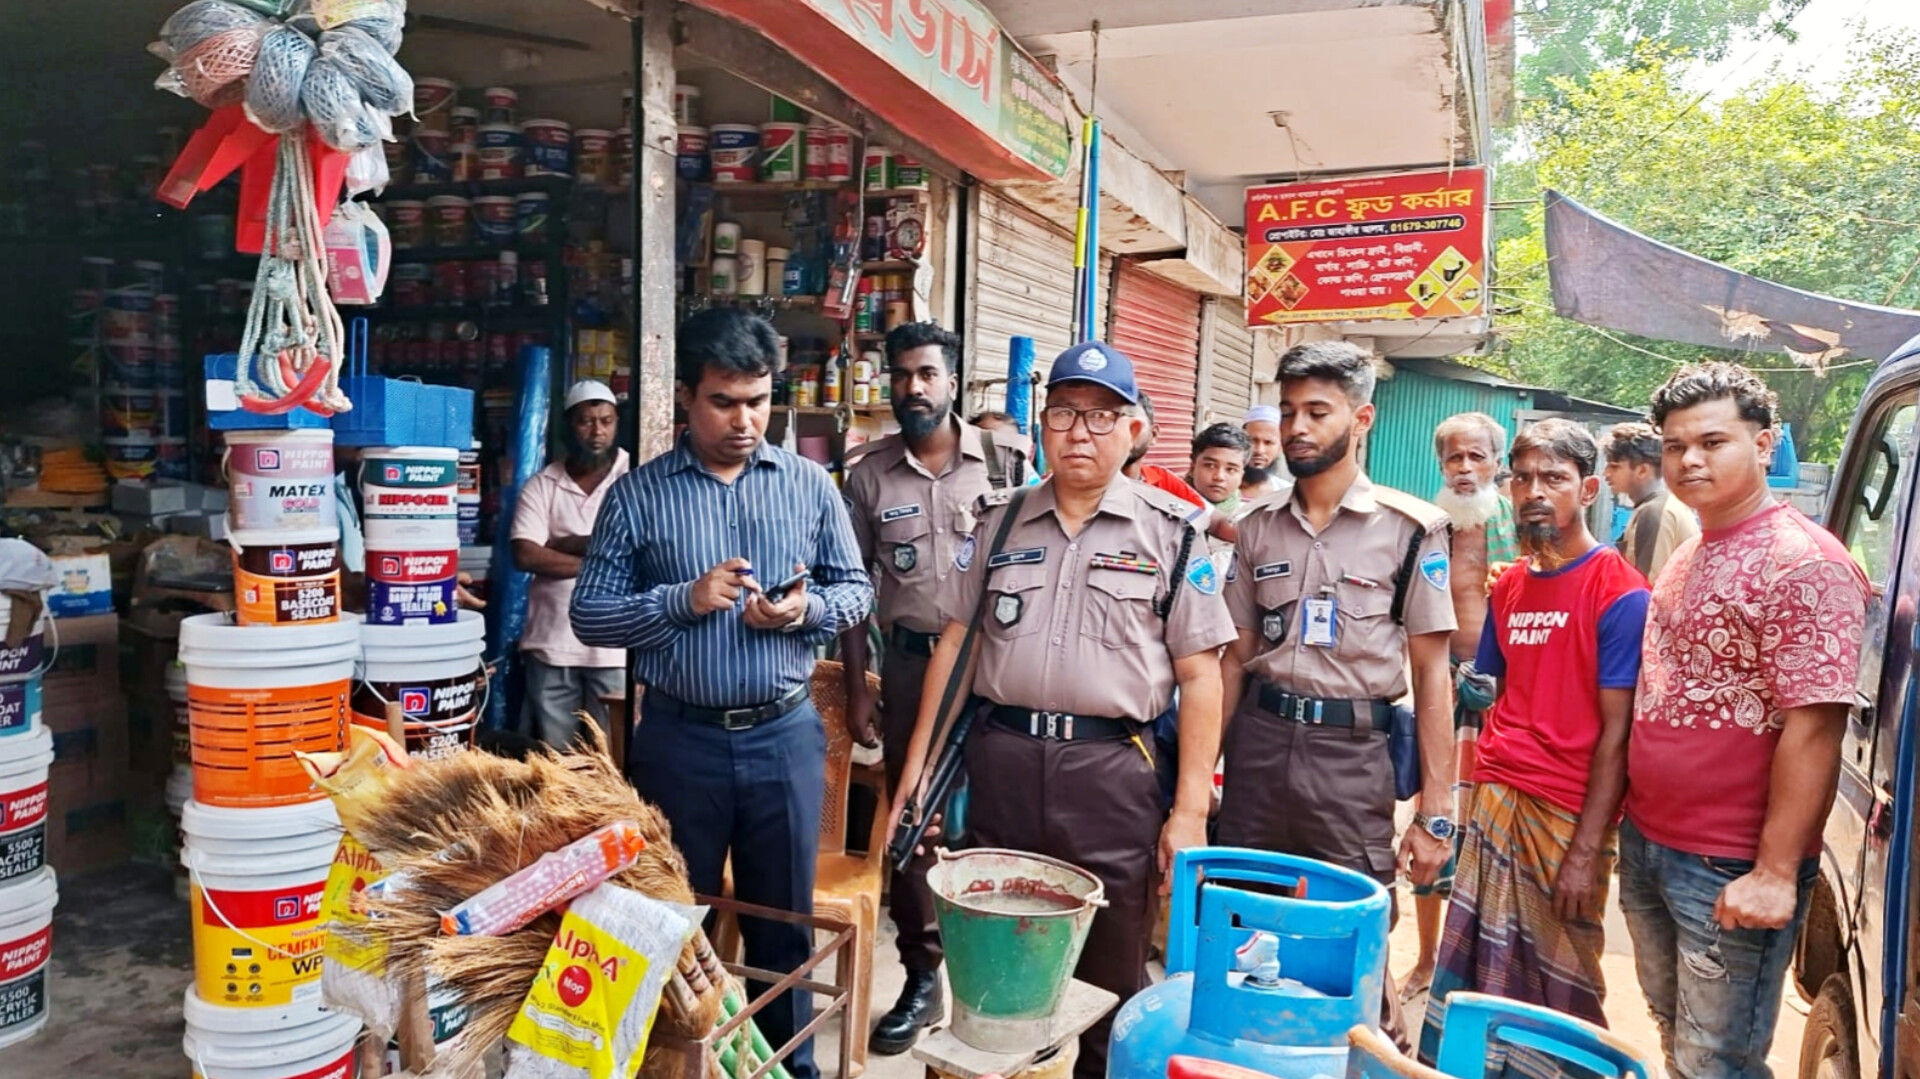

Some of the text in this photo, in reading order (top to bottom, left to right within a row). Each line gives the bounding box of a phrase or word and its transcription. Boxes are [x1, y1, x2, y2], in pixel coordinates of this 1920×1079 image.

[1257, 187, 1474, 222] A.F.C ফুড কর্নার
[292, 459, 327, 469] PAINT
[405, 466, 445, 475] NIPPON
[408, 474, 440, 482] PAINT
[269, 485, 327, 498] MATEX
[297, 548, 336, 561] NIPPON
[404, 556, 449, 566] NIPPON
[302, 558, 333, 570] PAINT
[407, 565, 443, 575] PAINT
[298, 587, 325, 599] 5200
[281, 596, 335, 610] BASECOAT
[291, 606, 331, 620] SEALER
[1507, 611, 1570, 628] NIPPON
[1508, 628, 1552, 645] PAINT
[433, 680, 476, 701] NIPPON
[437, 694, 471, 712] PAINT
[430, 733, 459, 749] 5200
[9, 791, 47, 811] NIPPON
[14, 802, 44, 821] PAINT
[8, 837, 34, 855] 5500
[334, 845, 383, 875] Alph
[2, 935, 47, 963] NIPPON
[6, 948, 42, 973] PAINT
[563, 975, 586, 996] Mop
[0, 992, 38, 1014] CRYLIC
[0, 1005, 35, 1026] EALER
